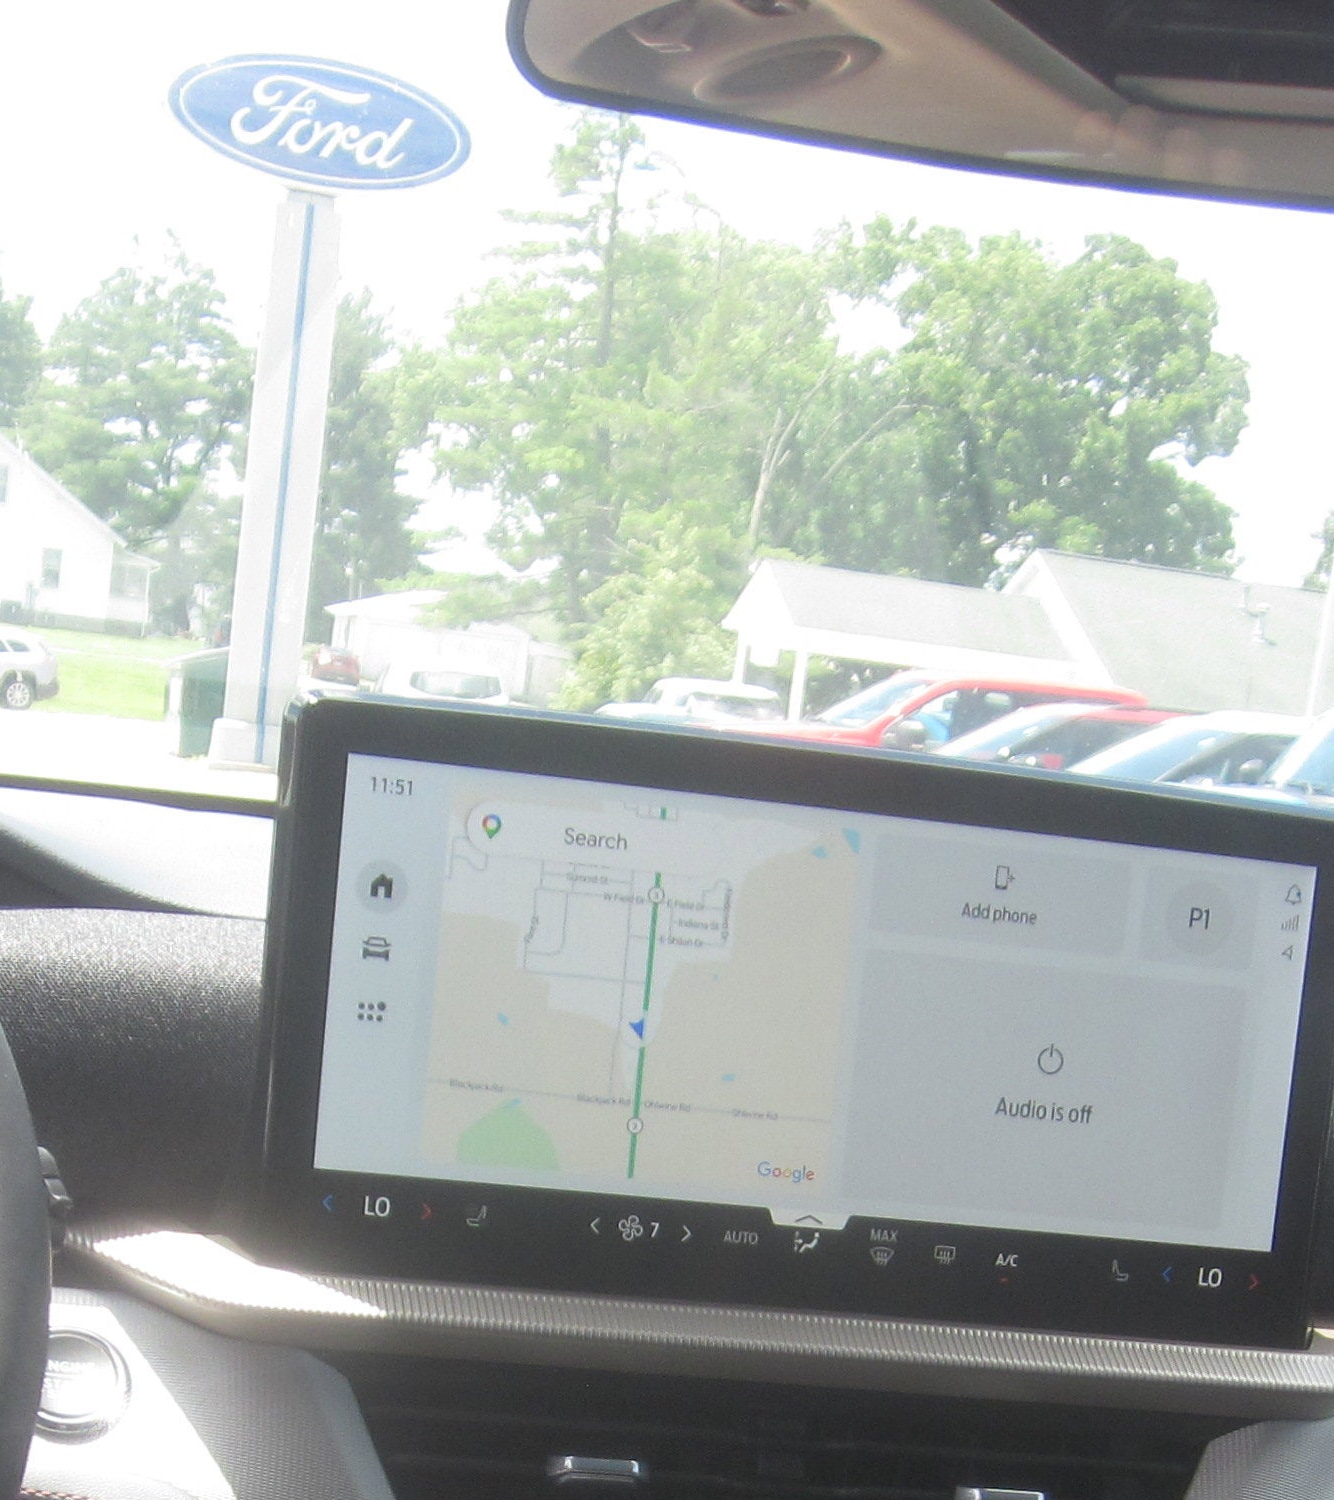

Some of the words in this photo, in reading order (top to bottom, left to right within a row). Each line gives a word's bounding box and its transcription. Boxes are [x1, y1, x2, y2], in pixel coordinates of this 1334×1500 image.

[230, 74, 415, 169] Ford
[369, 776, 415, 796] 11:51
[564, 827, 629, 851] Search
[961, 901, 990, 920] Add
[992, 903, 1038, 927] phone
[1188, 906, 1210, 931] P1
[994, 1097, 1048, 1121] Audio
[1050, 1101, 1065, 1122] is
[1068, 1103, 1094, 1124] off
[757, 1160, 816, 1184] Google
[364, 1195, 392, 1219] LO
[650, 1221, 660, 1238] 7
[723, 1229, 759, 1246] AUTO
[870, 1228, 899, 1243] MAX
[995, 1253, 1019, 1269] A/C
[1197, 1267, 1223, 1288] LO
